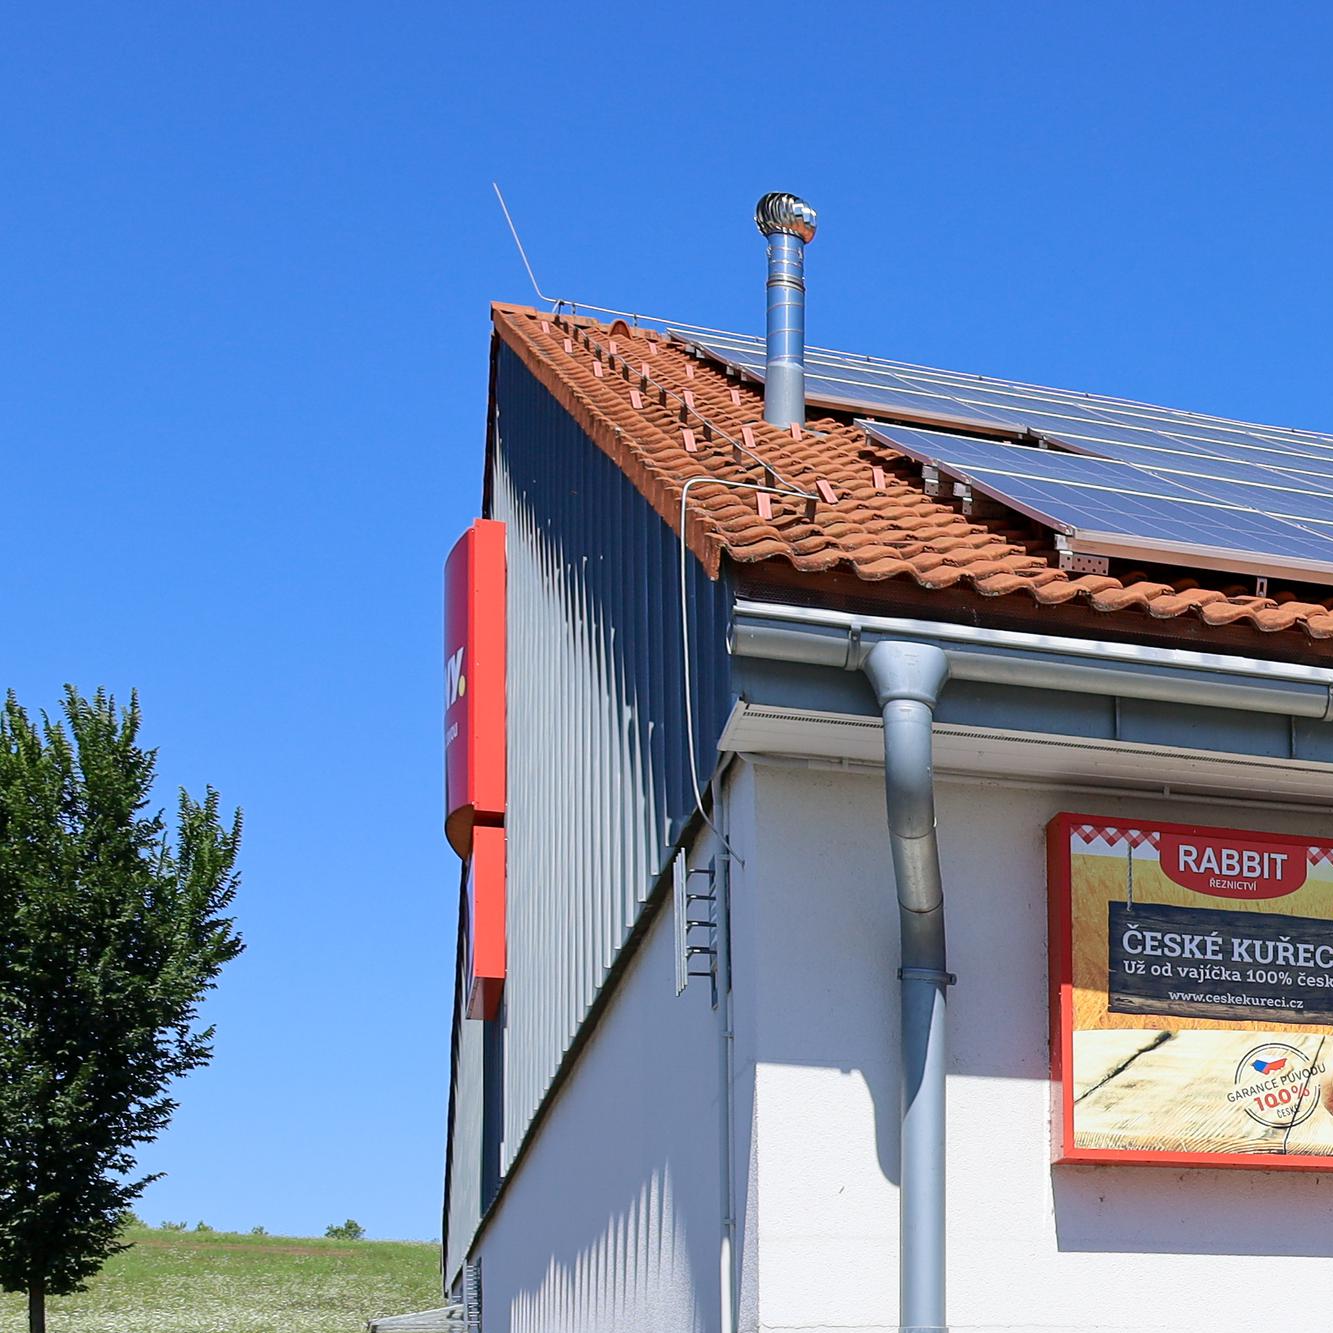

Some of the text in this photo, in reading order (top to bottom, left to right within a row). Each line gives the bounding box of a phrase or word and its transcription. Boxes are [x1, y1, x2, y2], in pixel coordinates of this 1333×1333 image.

[1178, 844, 1288, 881] RABBIT
[1209, 877, 1257, 891] ŘEZNICTVÍ
[1122, 923, 1223, 961] ČESKÉ
[1123, 960, 1146, 975] Už
[1151, 962, 1172, 977] od
[1177, 964, 1242, 983] vajíčka
[1246, 969, 1293, 986] 100%
[1168, 990, 1304, 1009] www.ceskekureci.cz
[1227, 1078, 1278, 1103] GARANCE
[1253, 1083, 1310, 1111] 100%
